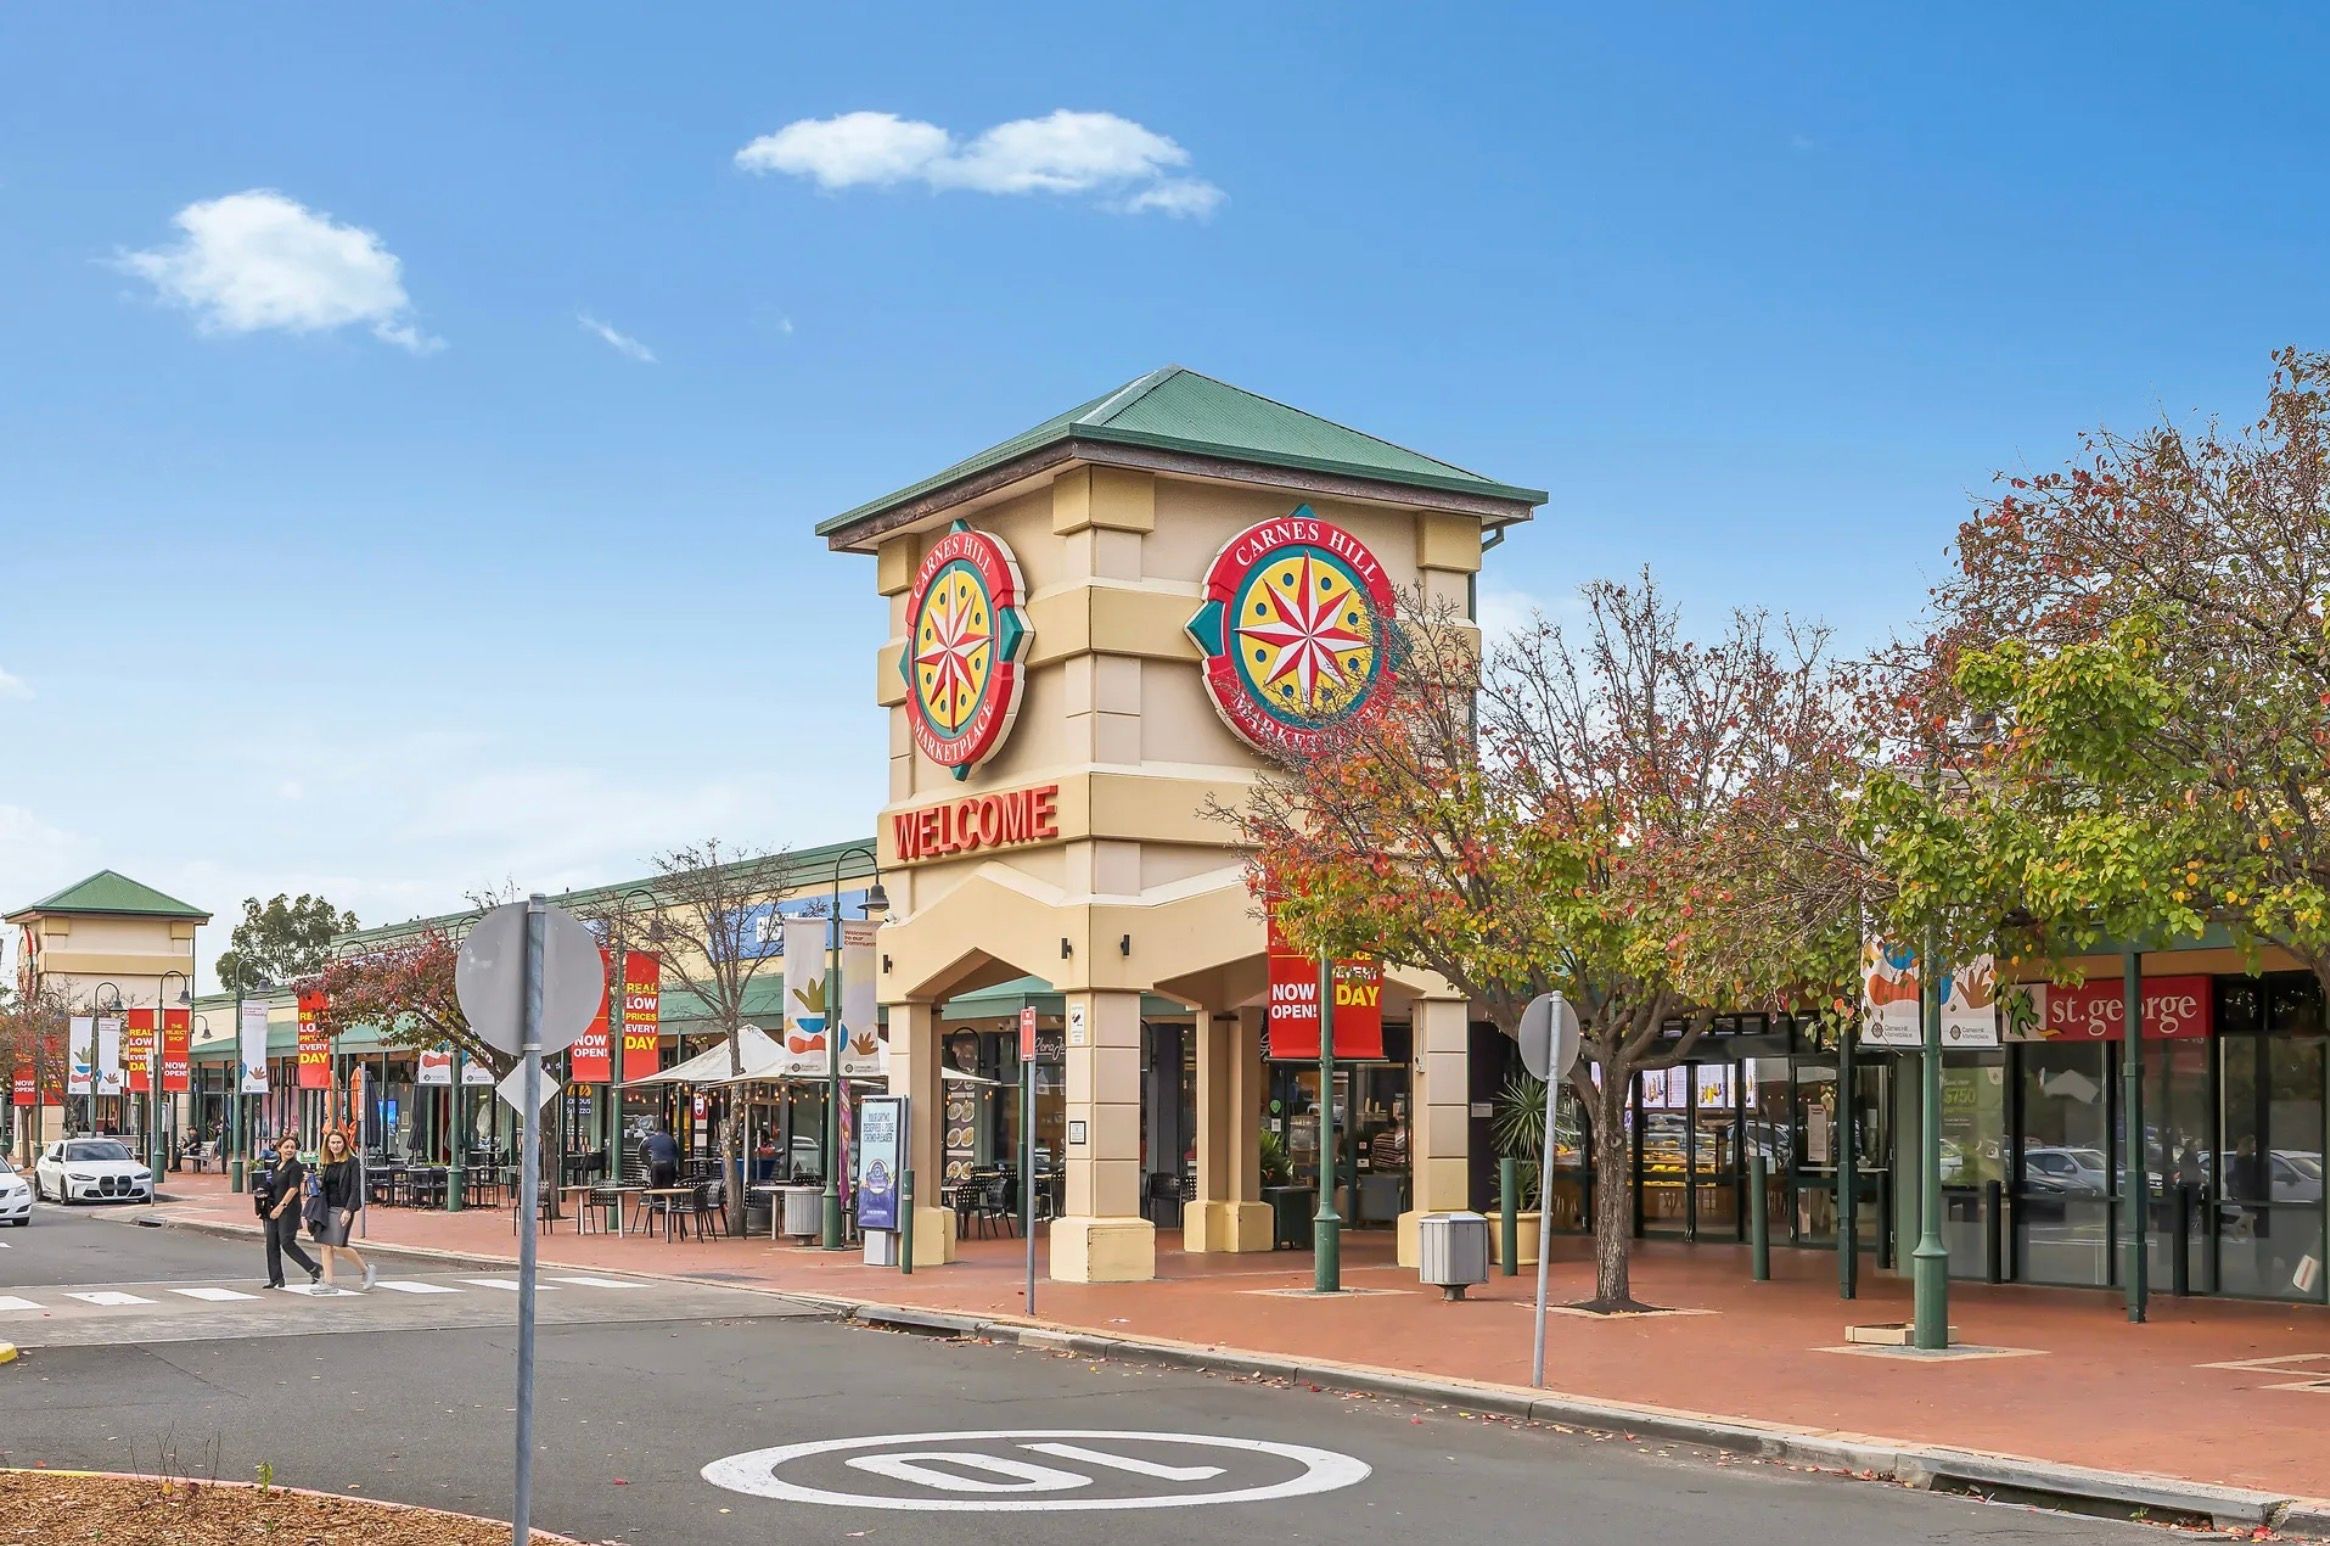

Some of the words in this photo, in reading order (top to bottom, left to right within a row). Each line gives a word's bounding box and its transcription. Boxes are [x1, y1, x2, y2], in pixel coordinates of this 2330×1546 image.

[1235, 521, 1320, 567] CARNES
[1328, 530, 1378, 584] HILL
[913, 535, 960, 600] CARNES
[963, 536, 992, 577] HILL
[912, 698, 995, 762] MARKETPLACE
[892, 784, 1059, 863] WELCOME
[626, 982, 658, 995] REAL
[1271, 983, 1316, 1001] NOW
[1336, 984, 1380, 1007] DAY
[626, 997, 657, 1010] LOW
[625, 1013, 657, 1021] PRICES
[1271, 1004, 1318, 1019] OPEN!
[2051, 994, 2197, 1037] st.gerge
[129, 1028, 153, 1037] REAL
[625, 1024, 657, 1034] EVERY
[129, 1037, 153, 1046] LOW
[299, 1043, 328, 1051] EVERY
[574, 1034, 607, 1047] NOW
[624, 1035, 657, 1051] DAY
[300, 1052, 328, 1065] DAY
[573, 1047, 608, 1058] OPEN!
[129, 1061, 147, 1072] DA
[164, 1062, 187, 1070] NOW
